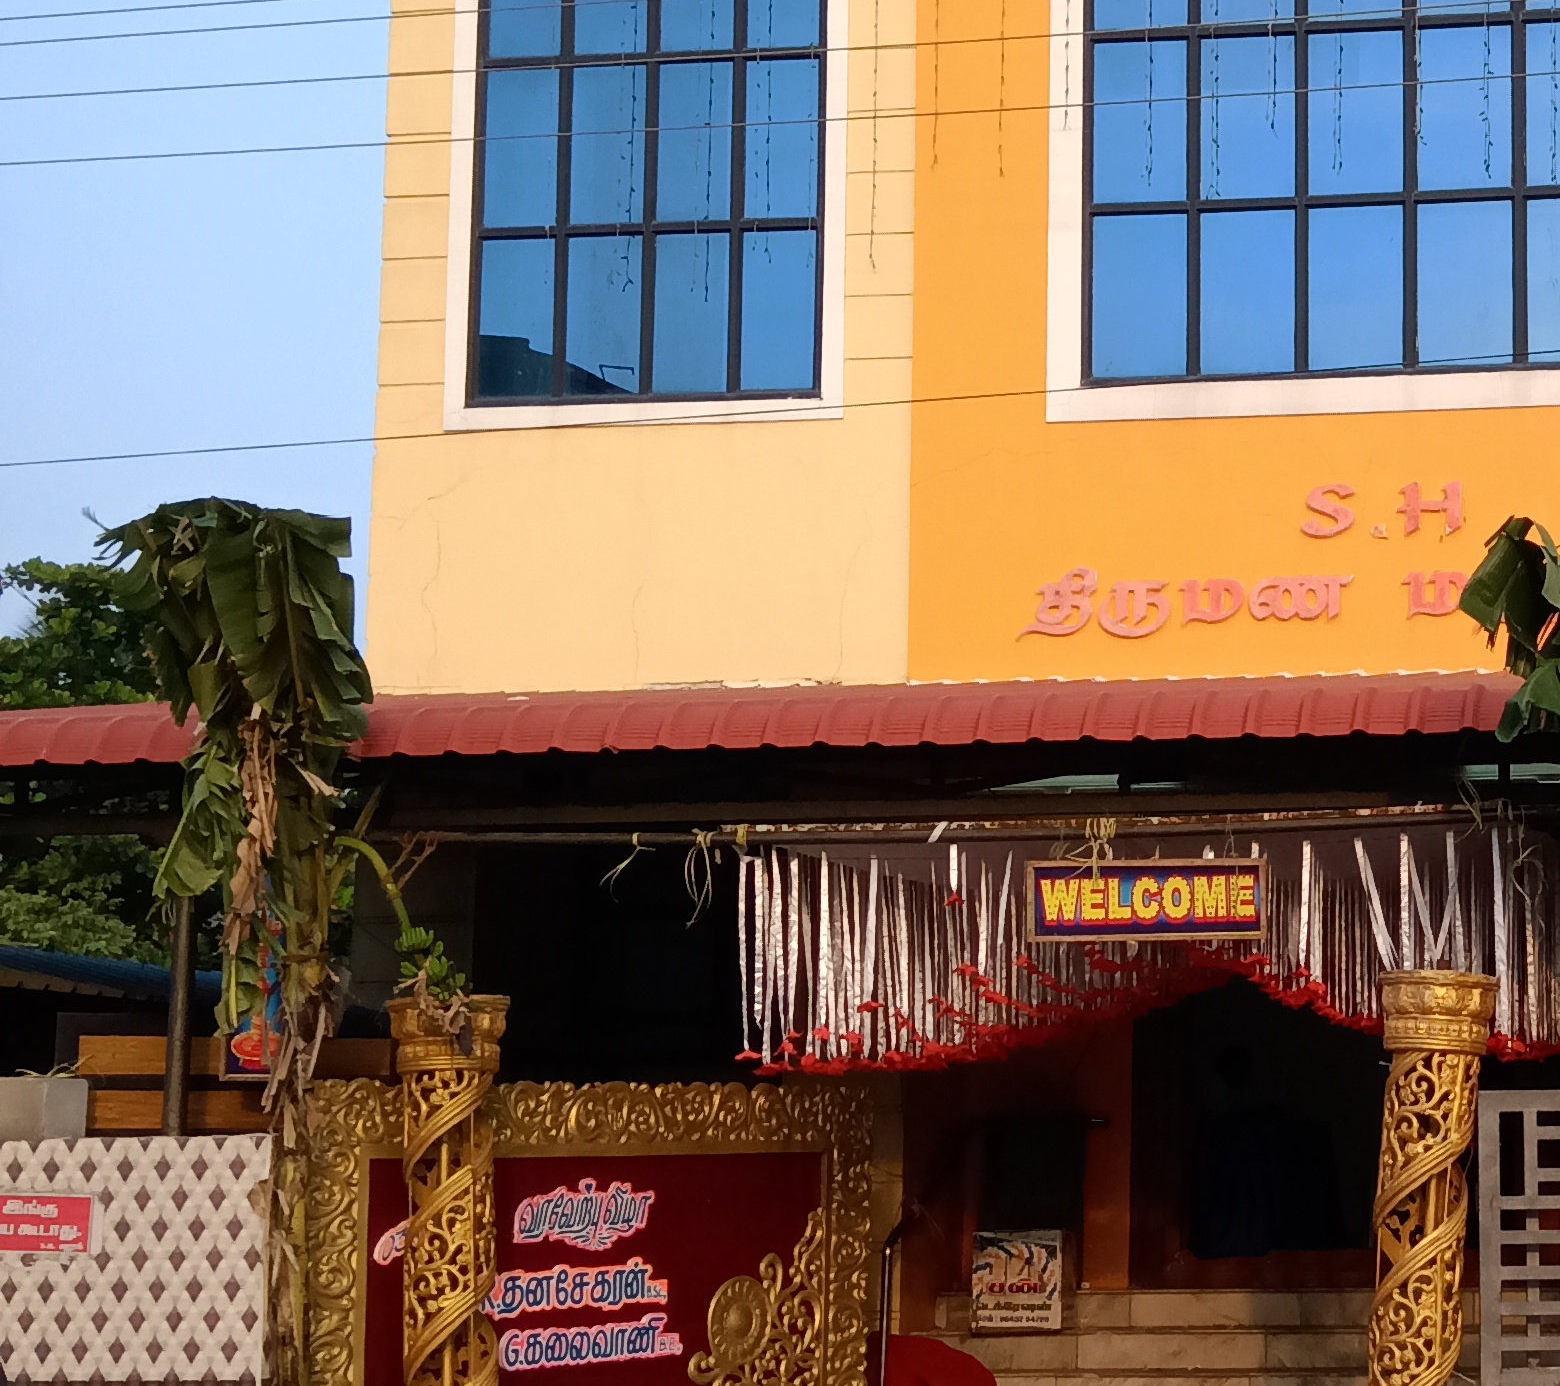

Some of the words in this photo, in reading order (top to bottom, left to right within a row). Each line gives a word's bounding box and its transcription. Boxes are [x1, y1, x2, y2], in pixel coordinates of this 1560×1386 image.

[1015, 565, 1355, 643] திருமண
[1039, 873, 1258, 925] WELCOME
[504, 1315, 666, 1366] G.கலைவாணி
